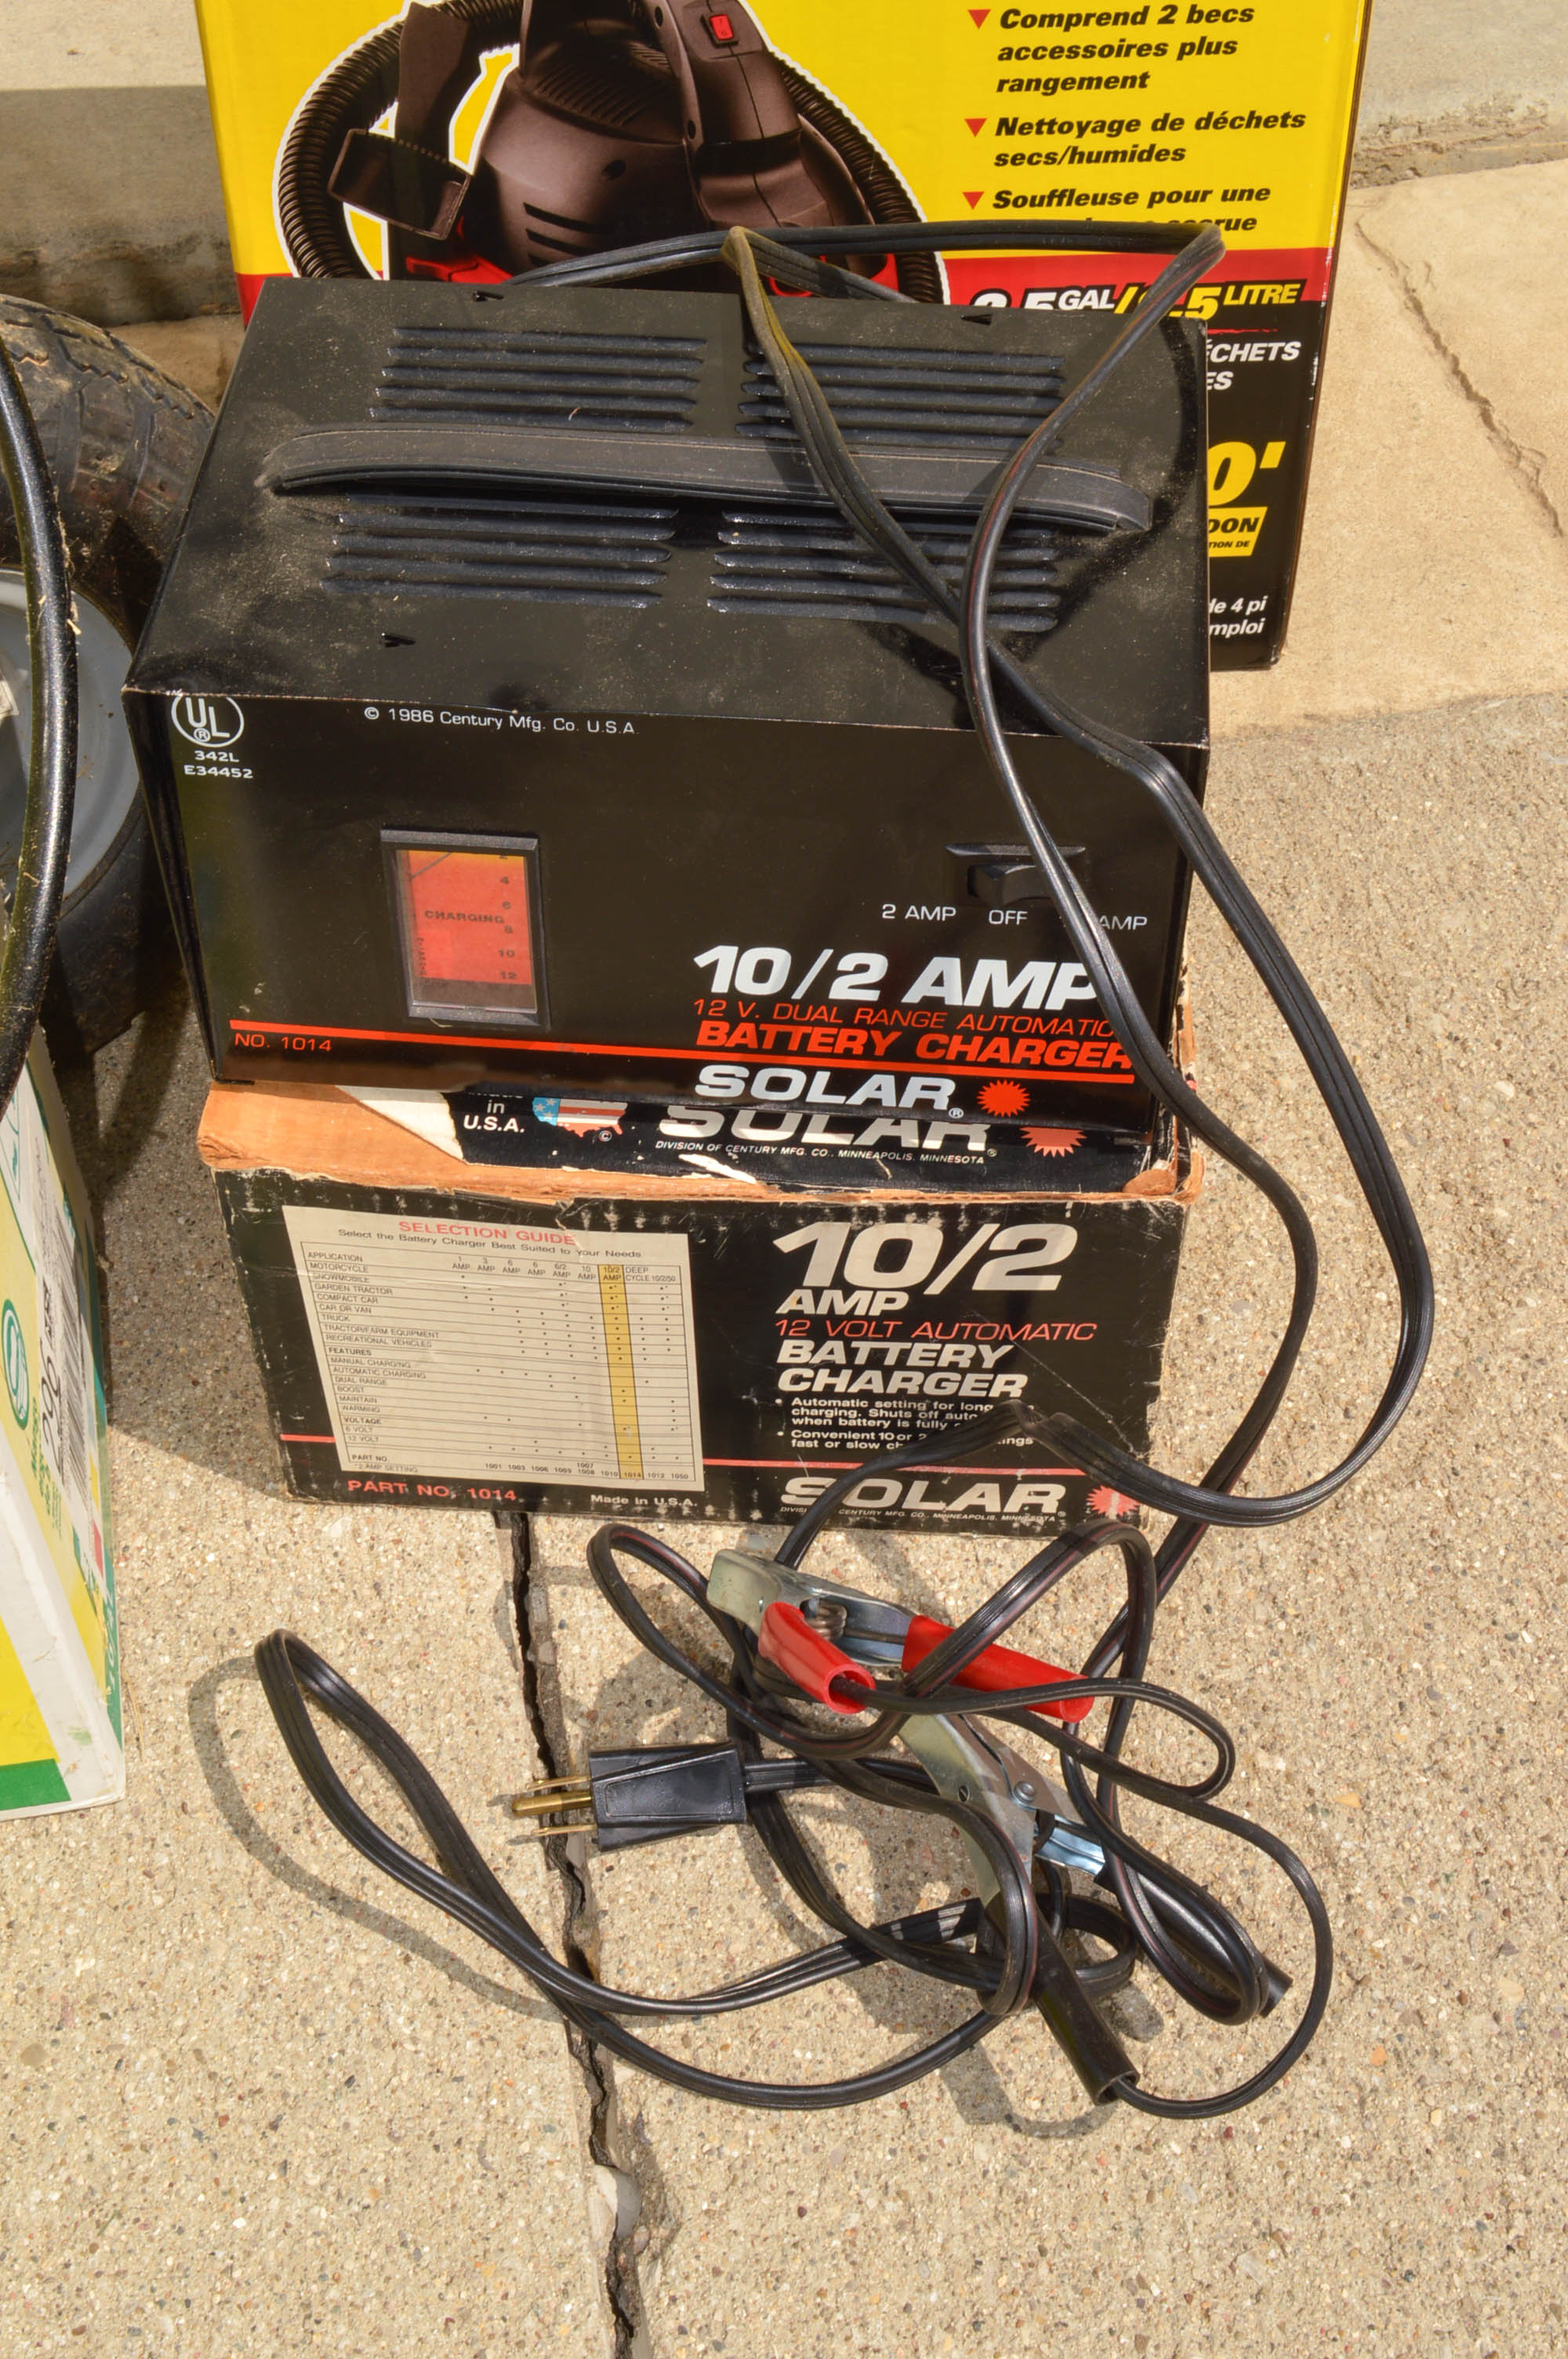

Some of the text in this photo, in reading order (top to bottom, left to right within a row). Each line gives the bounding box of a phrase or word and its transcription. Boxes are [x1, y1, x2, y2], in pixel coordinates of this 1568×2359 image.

[1000, 4, 1254, 32] Comprend 2 becs
[997, 36, 1238, 61] accessoires plus
[996, 71, 1151, 96] rangement
[995, 111, 1306, 138] Nettoyage de déchets
[993, 144, 1186, 167] secs/humides
[993, 187, 1270, 209] Souffleuse pour une
[1223, 284, 1301, 306] LITRE
[1231, 598, 1243, 612] 4
[1246, 596, 1269, 616] pi
[388, 708, 434, 723] 1986
[440, 711, 503, 730] Century
[510, 715, 546, 732] Mfg.
[553, 718, 579, 732] Co.
[587, 720, 640, 735] U.S.A.
[194, 751, 239, 763] 342L
[183, 765, 253, 779] E34452
[500, 876, 510, 885] 4
[424, 910, 504, 924] CHARGING
[882, 904, 1148, 931] 2 AMP OFF AMP
[498, 949, 515, 958] 10
[499, 971, 517, 980] 12
[694, 945, 1098, 1010] 10/2 AMP
[693, 998, 1115, 1037] 12 V. DUAL RANGE AUTOMATIC
[234, 1033, 332, 1052] NO. 1014
[696, 1021, 1133, 1070] BATTERY CHARGER
[487, 1100, 506, 1114] in
[463, 1115, 525, 1133] U.S.A.
[655, 1140, 704, 1153] DIVISION
[706, 1143, 722, 1153] OF
[725, 1144, 779, 1155] CENTURY
[780, 1147, 808, 1156] MFG.
[920, 1154, 985, 1165] MINNESOTA
[339, 1229, 372, 1238] Select
[377, 1231, 394, 1240] the
[399, 1234, 437, 1245] Battery
[442, 1238, 485, 1249] Charger
[491, 1241, 516, 1250] Best
[521, 1243, 555, 1253] Suited
[398, 1221, 575, 1245] SELECTION GUIDE
[308, 1252, 362, 1262] APPLICATION
[772, 1222, 1078, 1295] 10/2
[310, 1263, 369, 1273] MOTORCYCLE
[314, 1283, 393, 1295] GARDEN TRACTOR
[316, 1293, 379, 1304] COMPACT CAR
[775, 1289, 909, 1316] AMP
[321, 1314, 350, 1322] TRUCK
[324, 1324, 439, 1339] TRACTOR/FARM EQUIPMENT
[775, 1319, 1098, 1340] 12 VOLT AUTOMATIC
[325, 1334, 432, 1347] RECREATIONAL VEHICLES
[328, 1347, 372, 1357] FEATURES
[776, 1339, 1014, 1369] BATTERY
[330, 1357, 411, 1369] MANUAL CHARGING
[333, 1367, 426, 1379] AUTOMATIC CHARGING
[778, 1368, 1028, 1398] CHARGER
[791, 1398, 993, 1413] Automatic setting for long
[343, 1416, 382, 1425] VOLTAGE
[791, 1408, 862, 1420] charging.
[868, 1408, 913, 1419] Shuts
[919, 1410, 940, 1419] off
[791, 1417, 948, 1430] when battery is fully
[791, 1430, 877, 1441] Convenient
[878, 1432, 893, 1441] 10
[791, 1439, 818, 1448] fast
[825, 1440, 840, 1448] or
[847, 1440, 880, 1449] slow
[347, 1480, 407, 1494] PART
[467, 1488, 517, 1501] 1014
[590, 1495, 698, 1507] Made in U.S.A.
